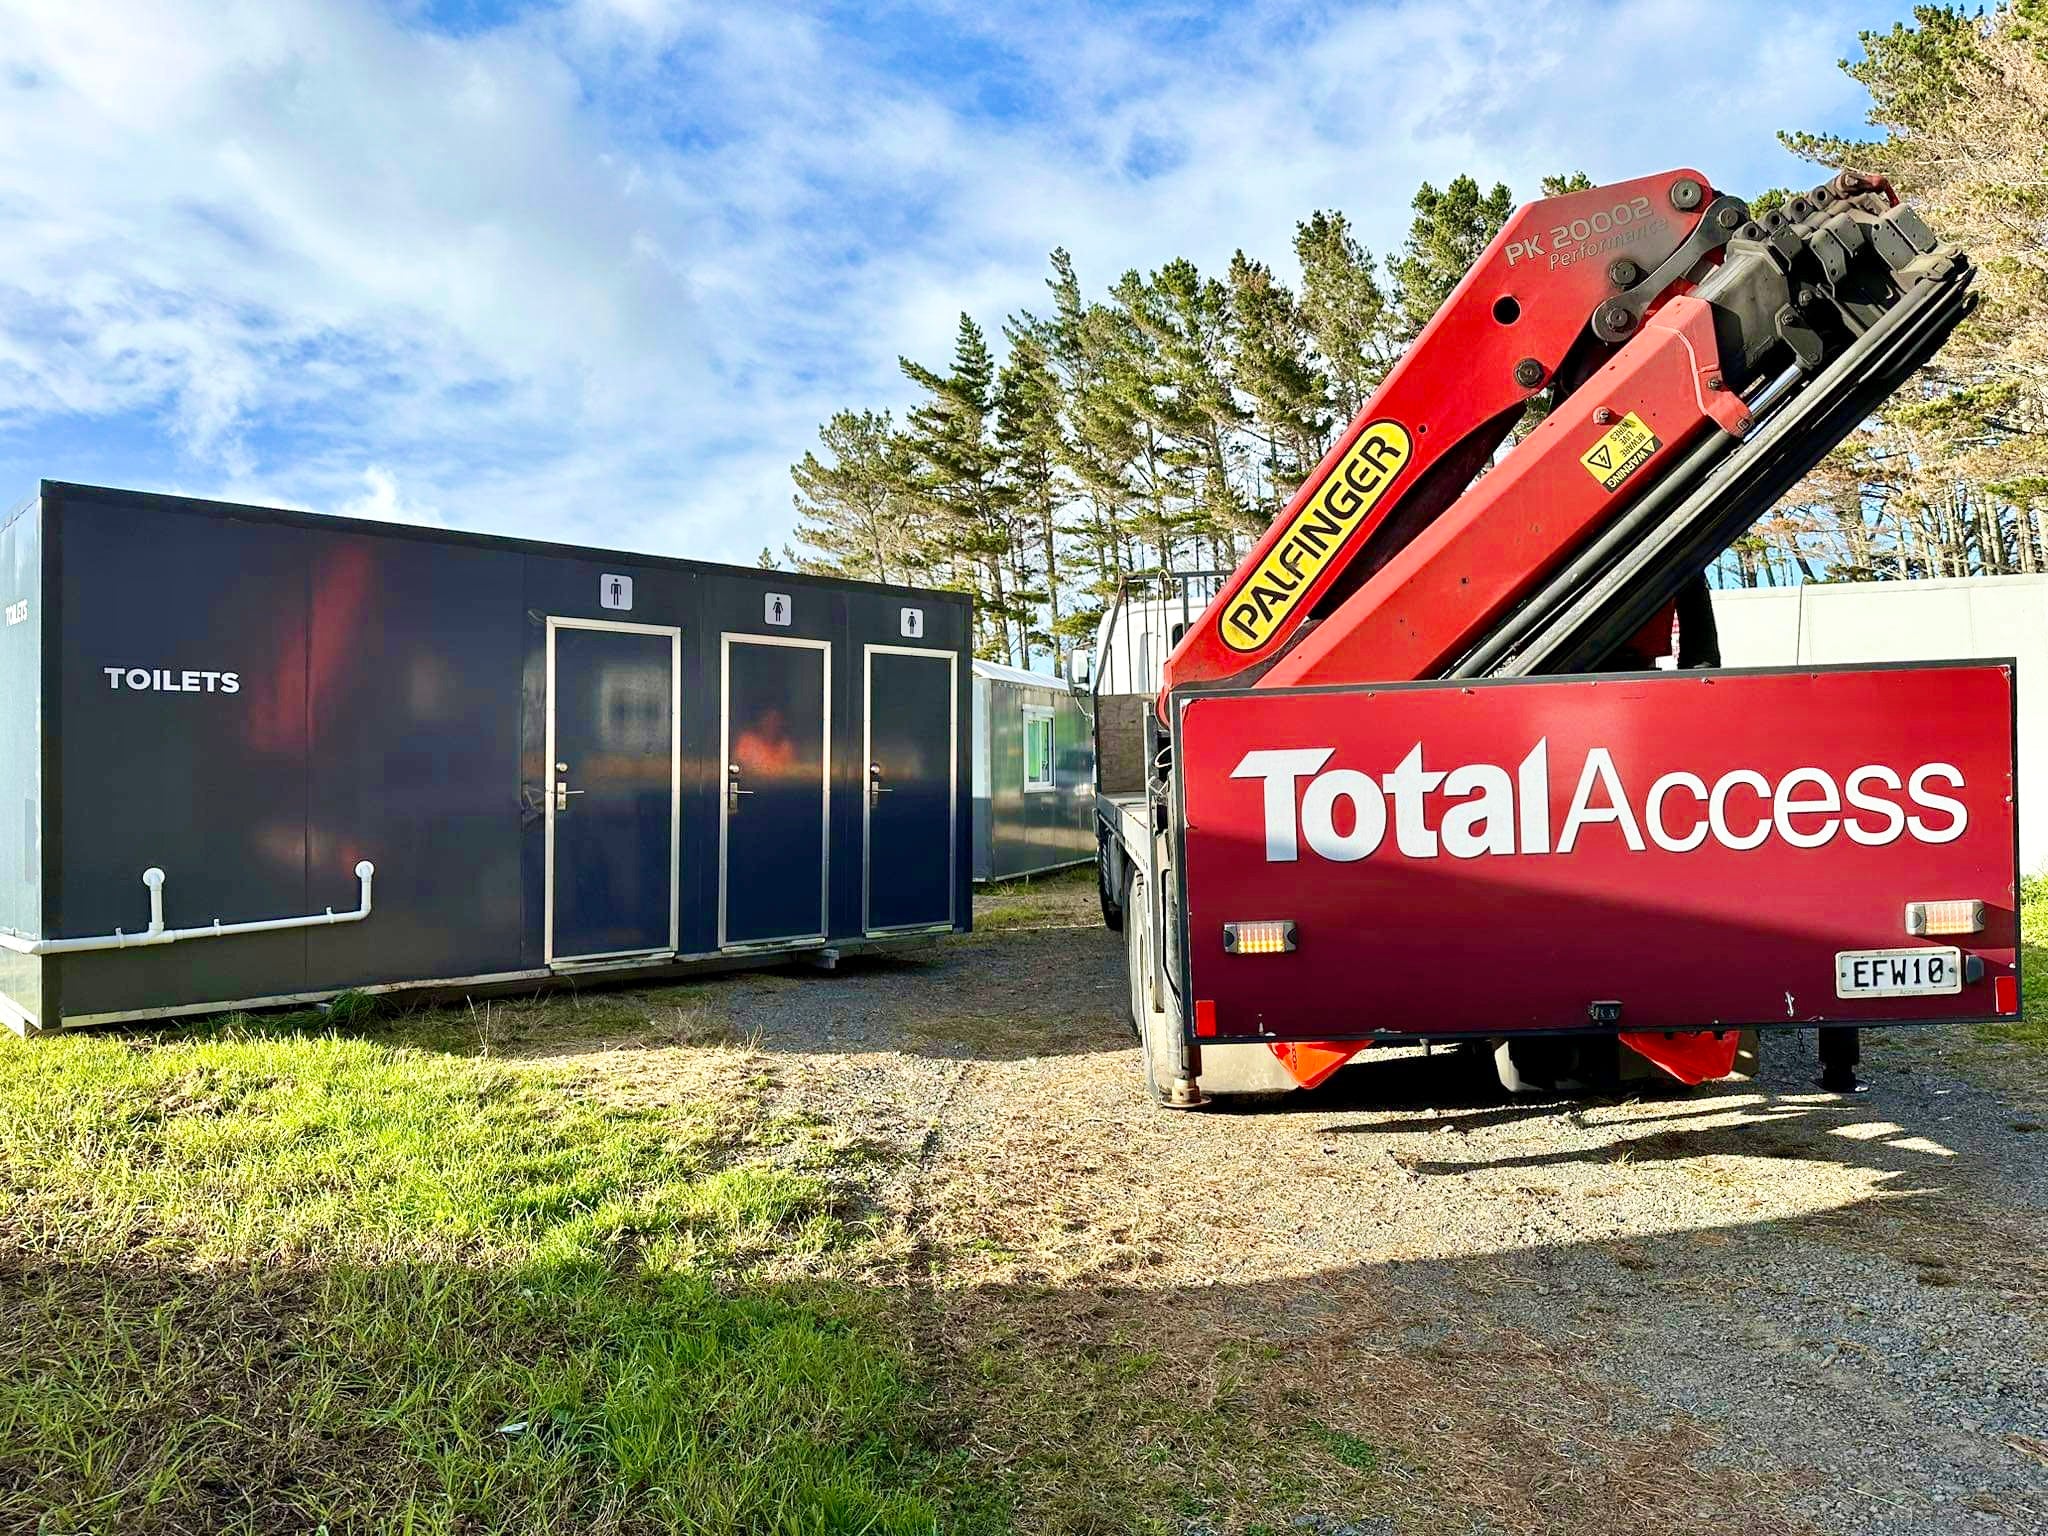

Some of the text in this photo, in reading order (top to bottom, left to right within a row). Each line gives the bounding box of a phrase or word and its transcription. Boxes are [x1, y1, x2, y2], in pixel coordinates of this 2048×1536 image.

[1504, 196, 1653, 266] PK 20002
[1609, 421, 1632, 442] WIRES
[1619, 430, 1634, 446] LIVE
[1619, 432, 1646, 458] BEWARE
[1606, 449, 1649, 488] WARNING
[1229, 435, 1402, 640] PALFINGER
[103, 667, 240, 694] TOILETS
[1853, 957, 1944, 988] EFW10
